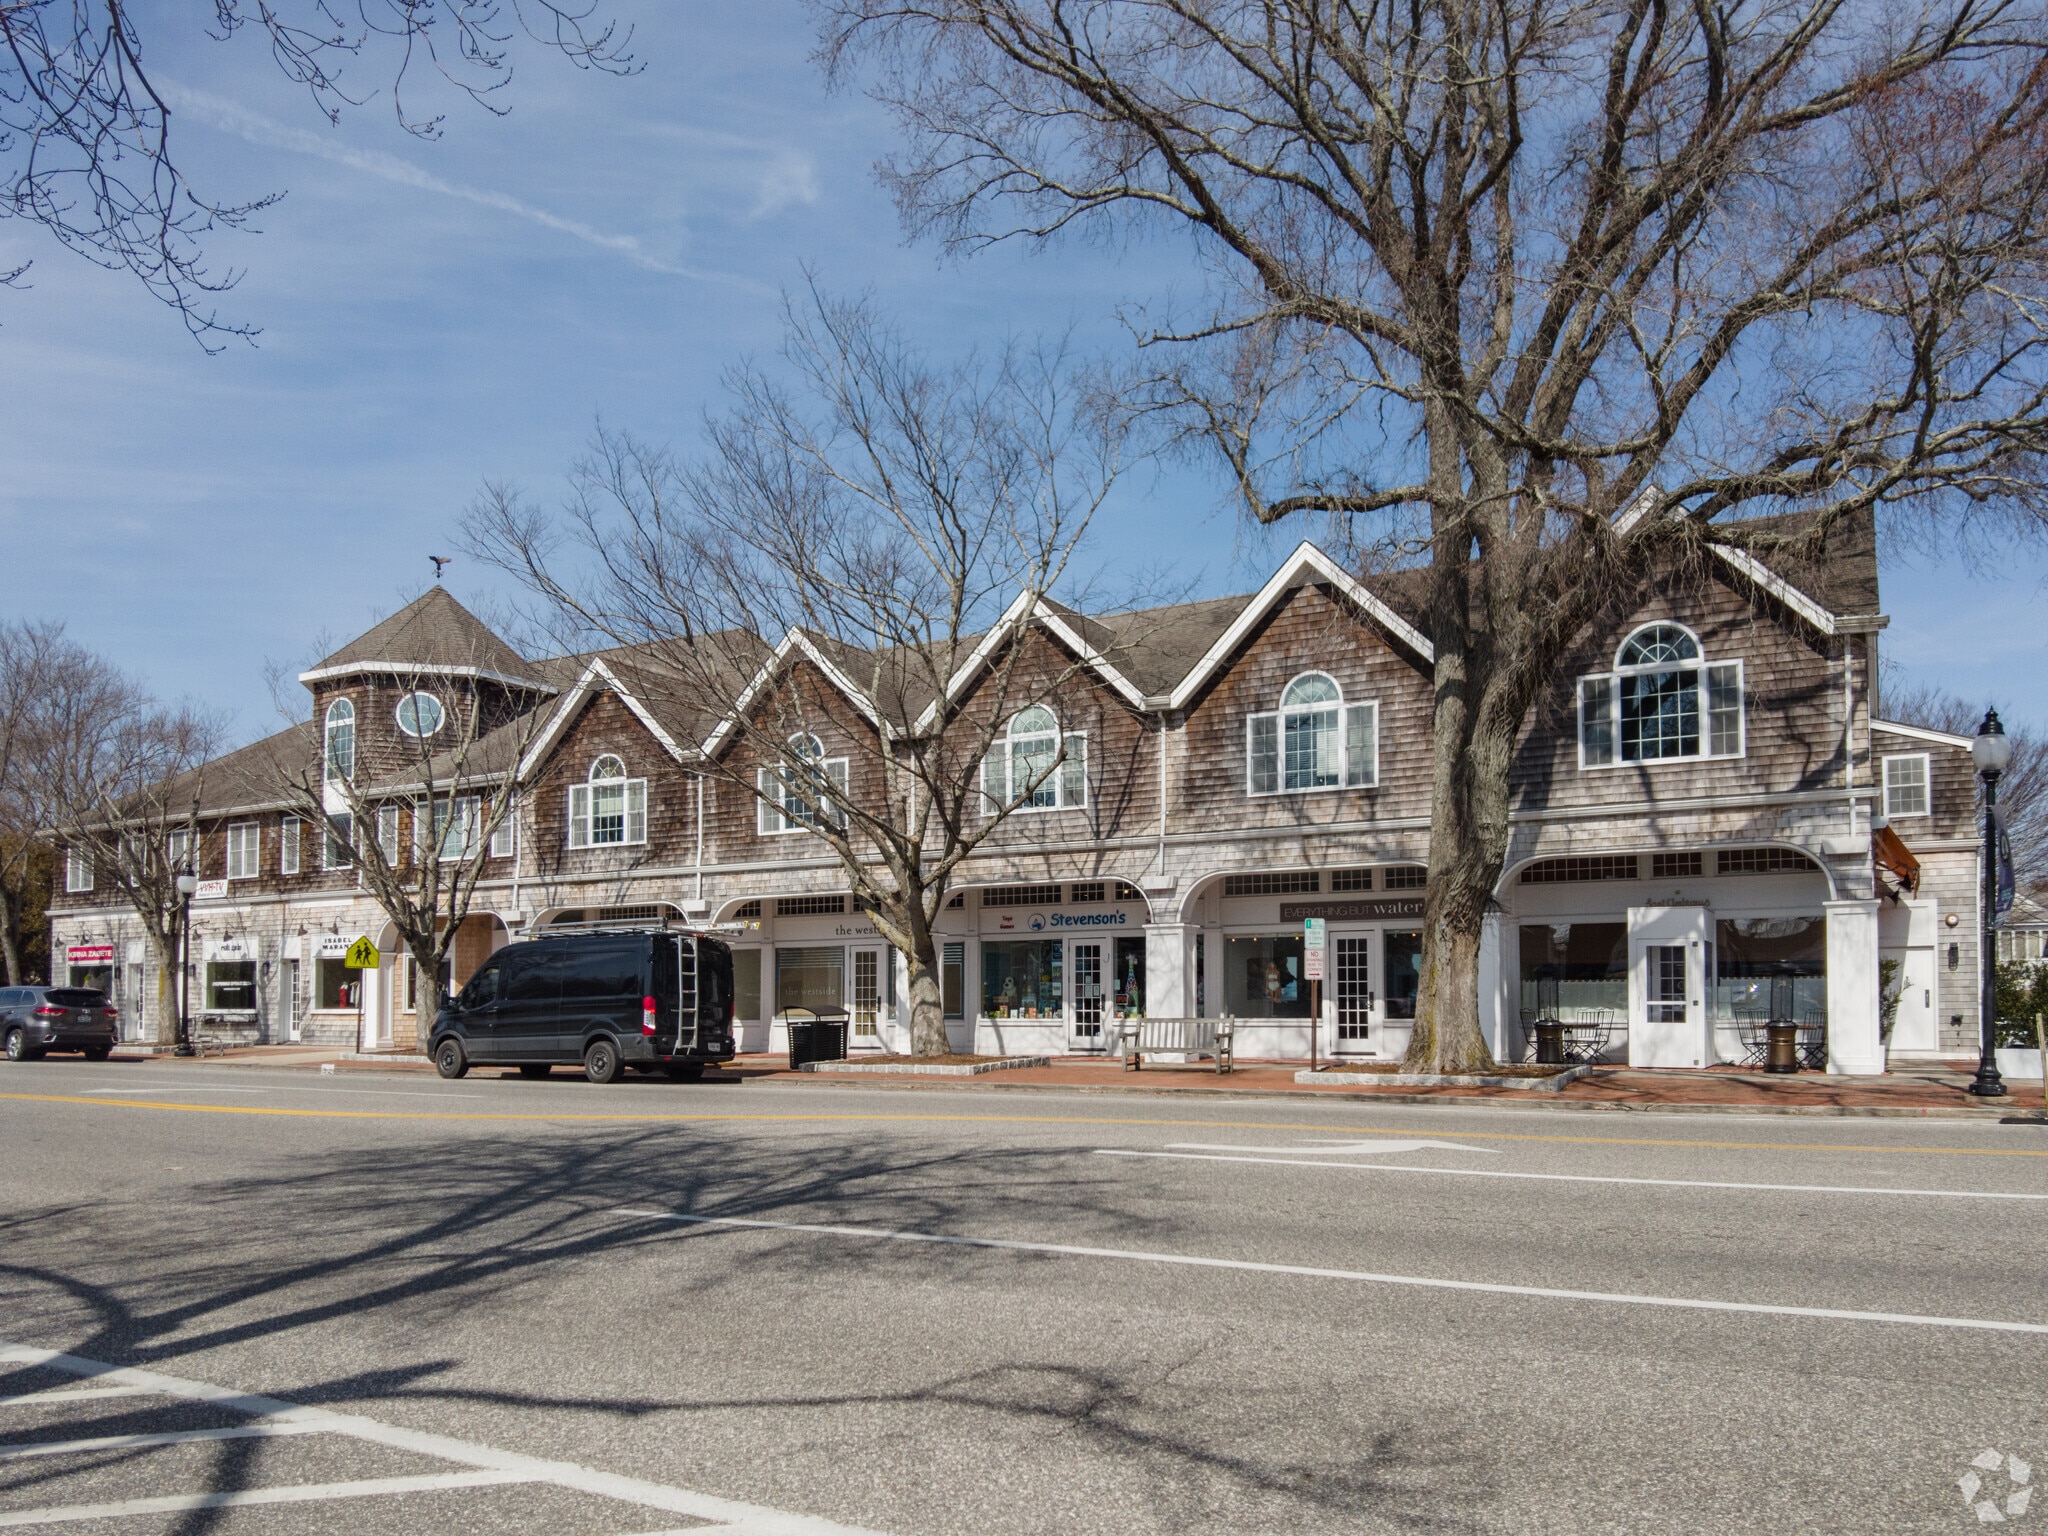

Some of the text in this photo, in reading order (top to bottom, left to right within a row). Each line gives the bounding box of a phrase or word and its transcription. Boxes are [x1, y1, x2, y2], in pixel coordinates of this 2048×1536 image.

[1284, 902, 1423, 918] EVERYTHING BUT water
[1050, 909, 1126, 927] Stevenson's
[835, 925, 852, 935] the
[785, 986, 836, 995] the westside
